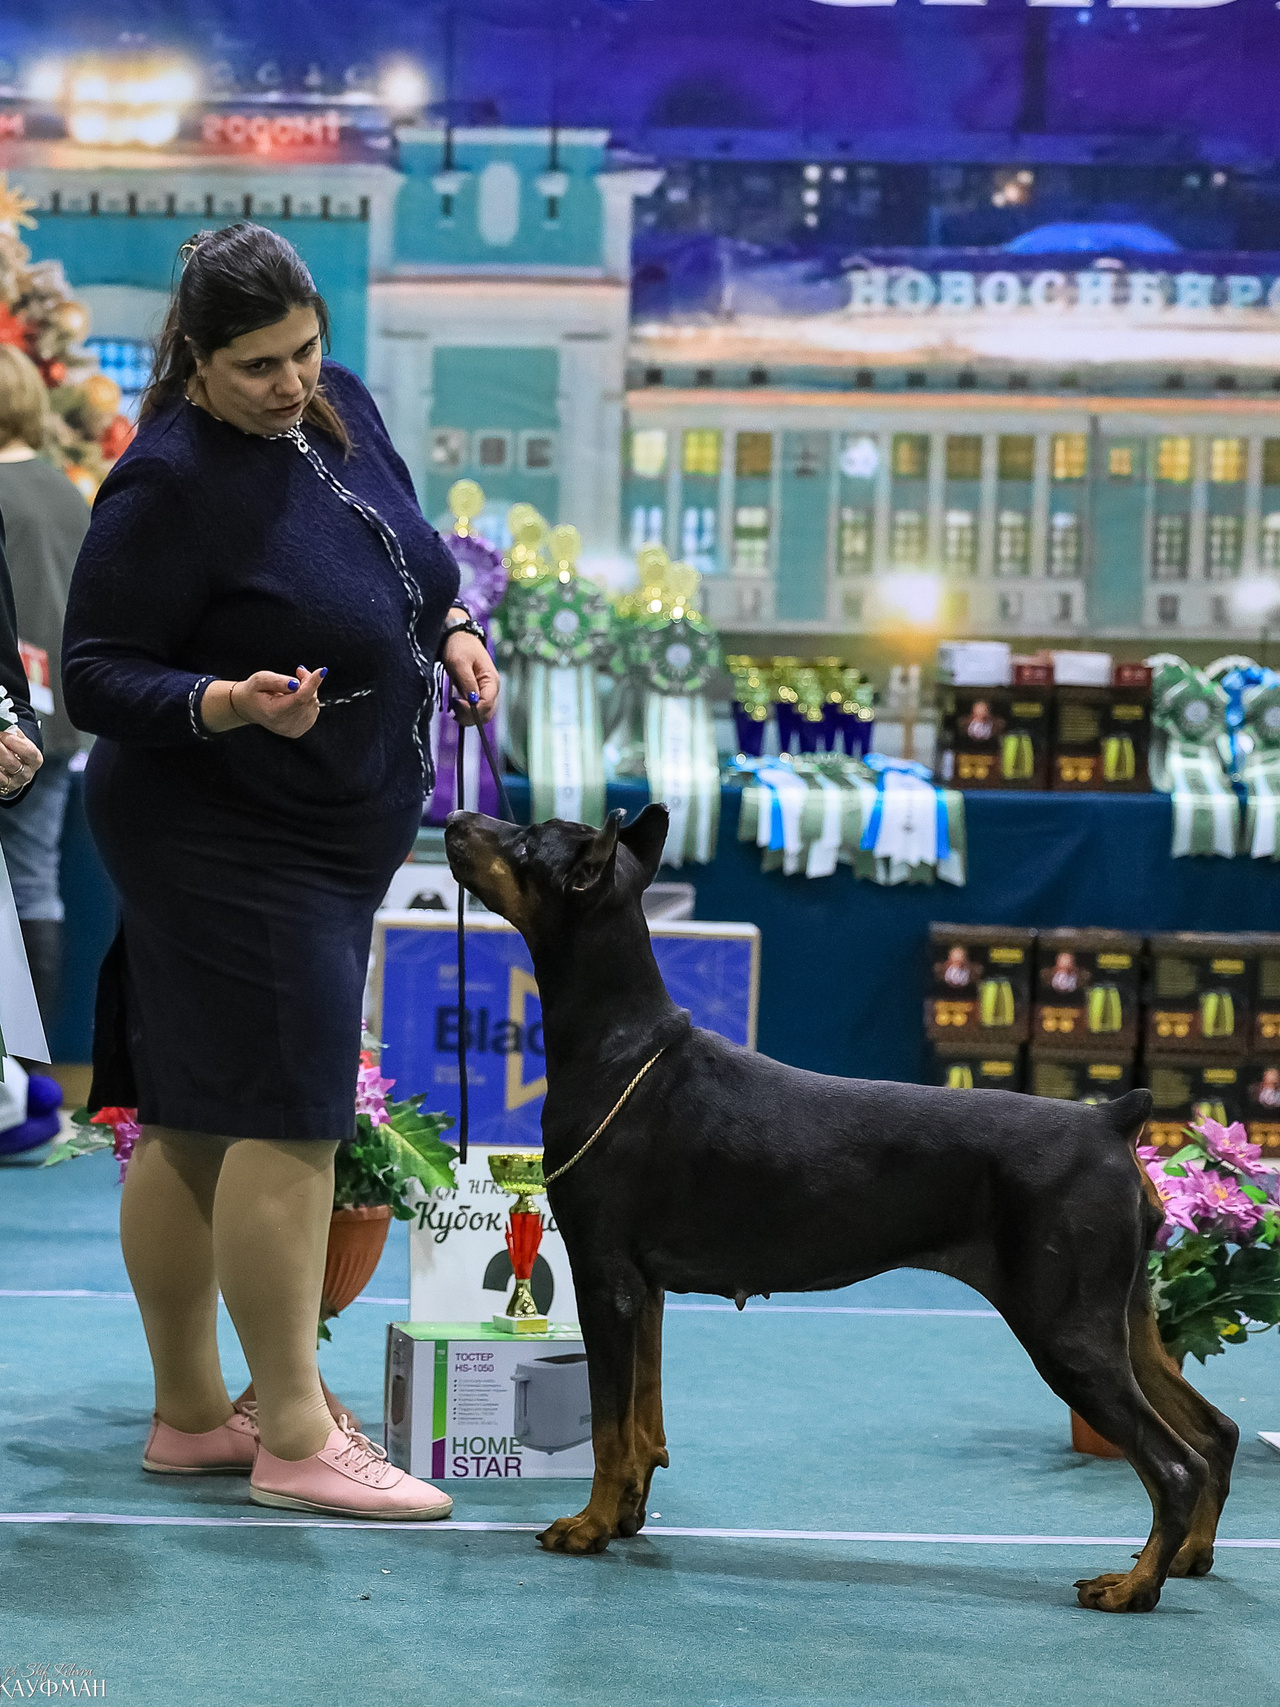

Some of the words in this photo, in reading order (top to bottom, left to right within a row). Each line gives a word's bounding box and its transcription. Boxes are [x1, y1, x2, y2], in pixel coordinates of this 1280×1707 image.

[414, 1201, 503, 1243] Кубок
[455, 1352, 494, 1362] ТОСТЕР
[454, 1363, 495, 1373] HS-1050
[452, 1436, 523, 1455] HOME
[452, 1456, 522, 1478] STAR
